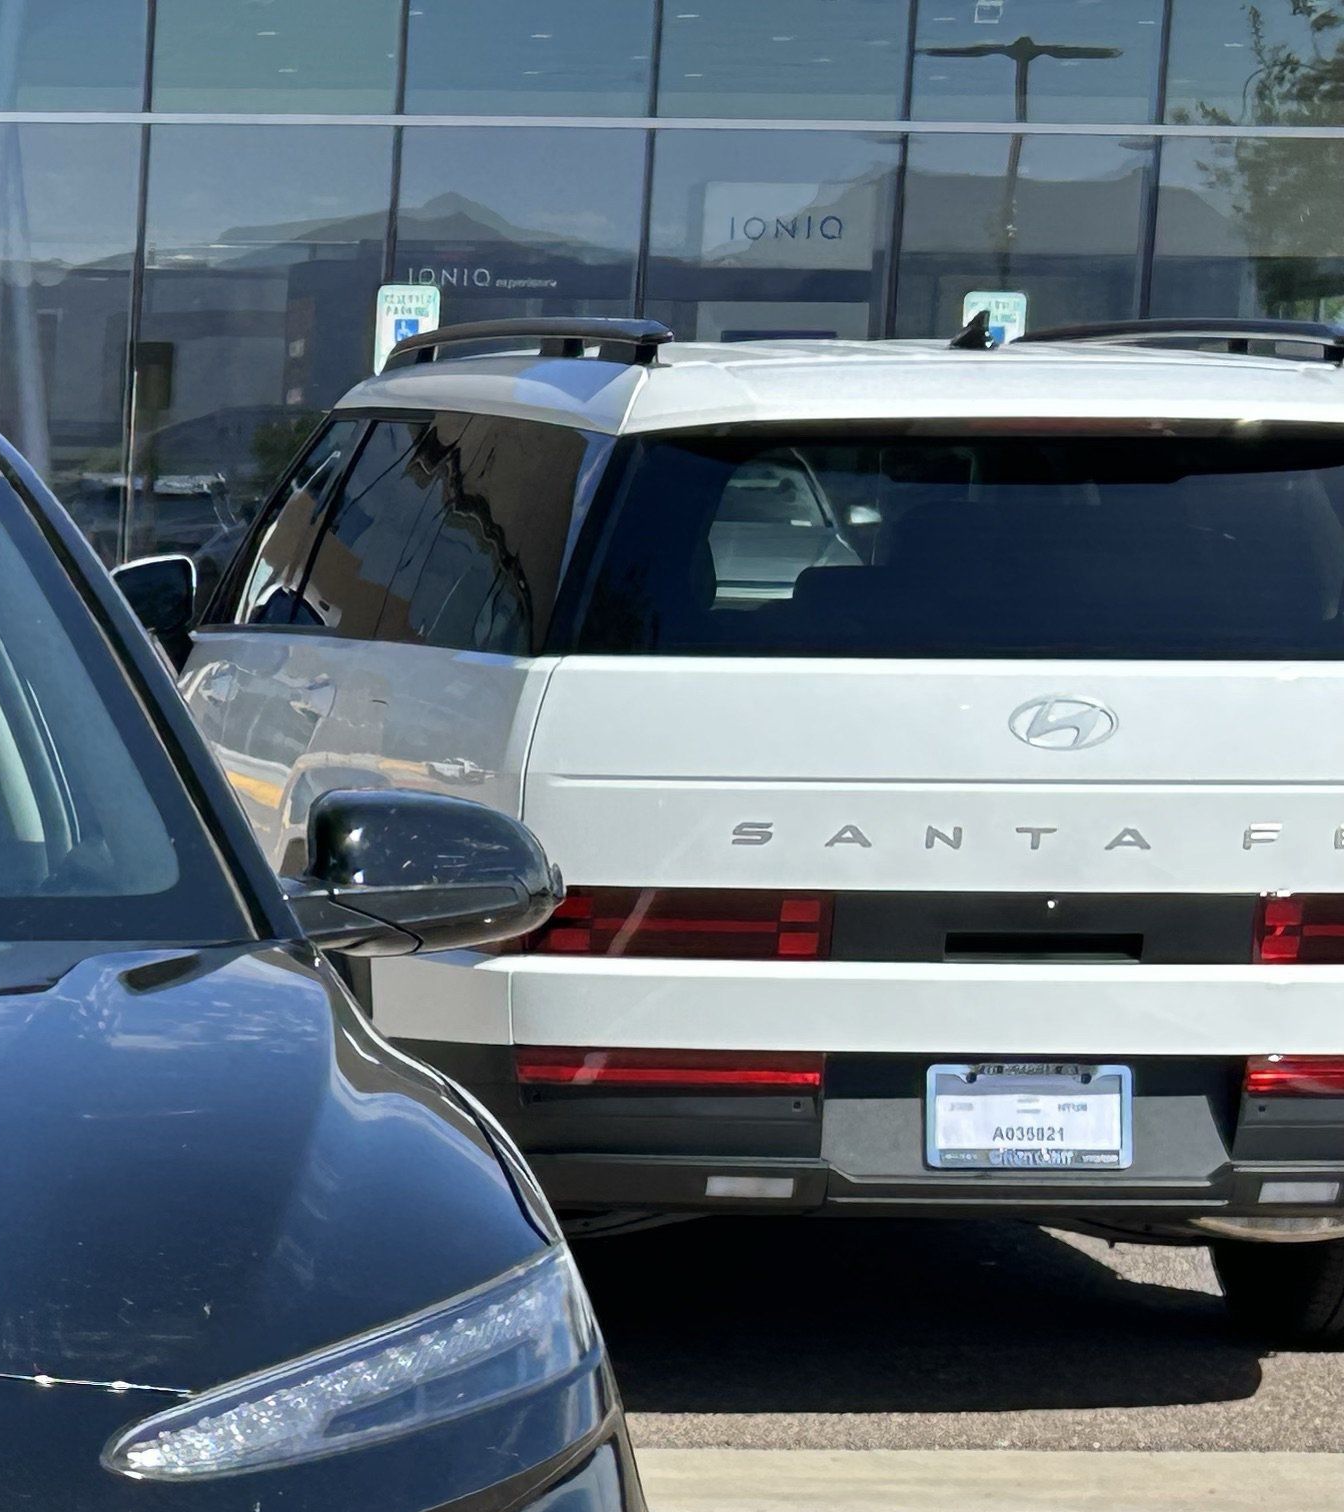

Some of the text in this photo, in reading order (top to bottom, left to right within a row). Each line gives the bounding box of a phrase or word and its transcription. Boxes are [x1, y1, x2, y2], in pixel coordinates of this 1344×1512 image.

[730, 215, 843, 240] IONIQ
[408, 267, 491, 287] IONIQ
[731, 822, 1344, 850] SANTA F
